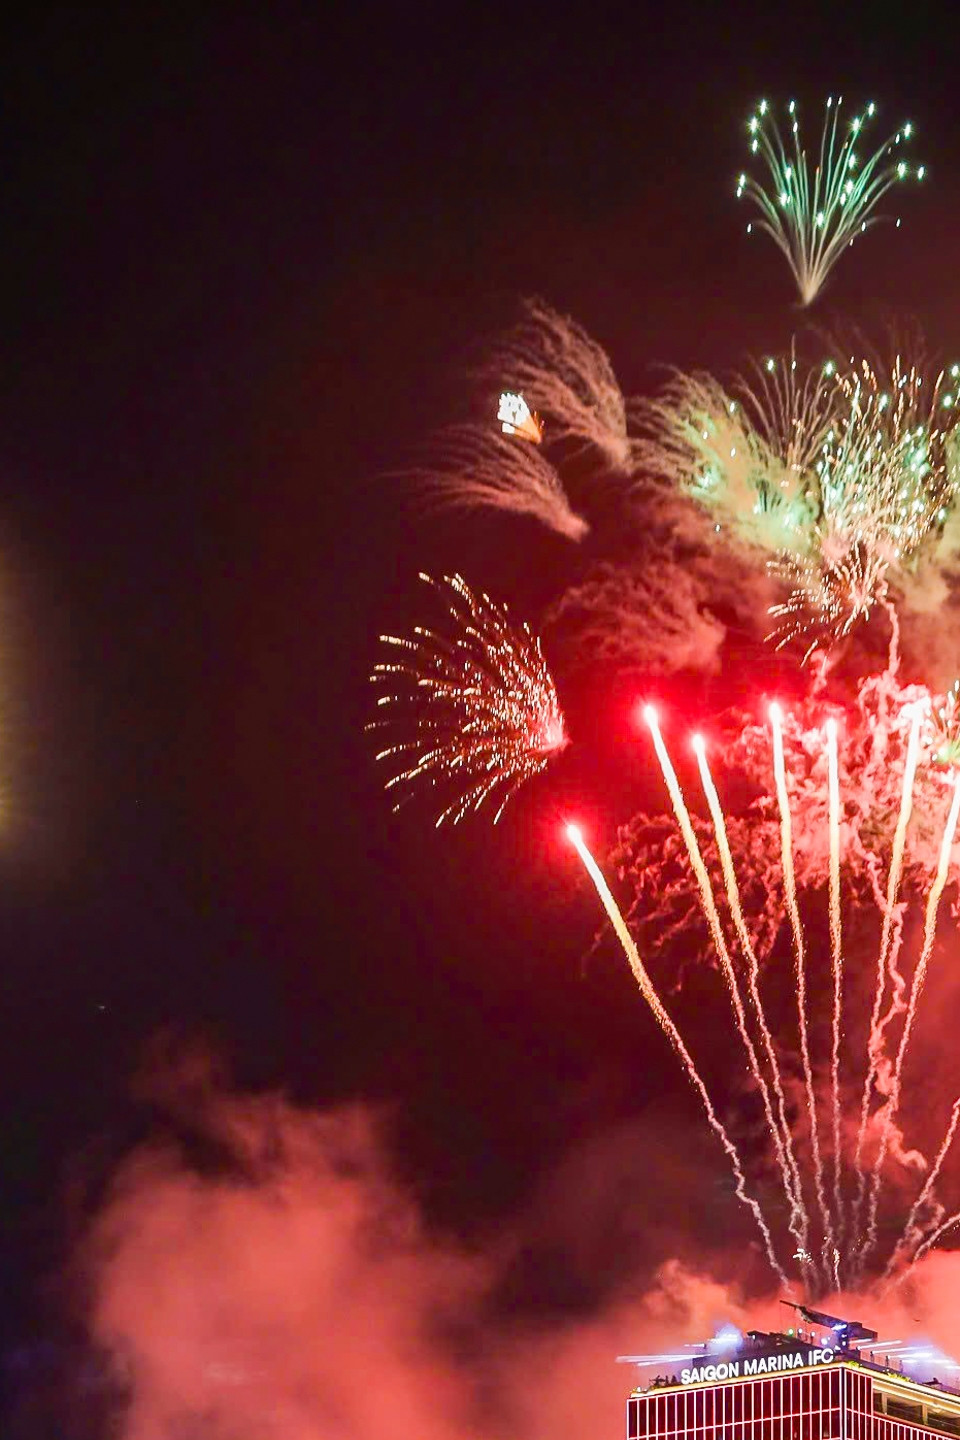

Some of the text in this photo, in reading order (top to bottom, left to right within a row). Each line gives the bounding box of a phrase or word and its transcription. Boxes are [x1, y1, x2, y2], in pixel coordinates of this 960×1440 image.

[681, 1348, 834, 1385] SAIGON MARINA IFC
